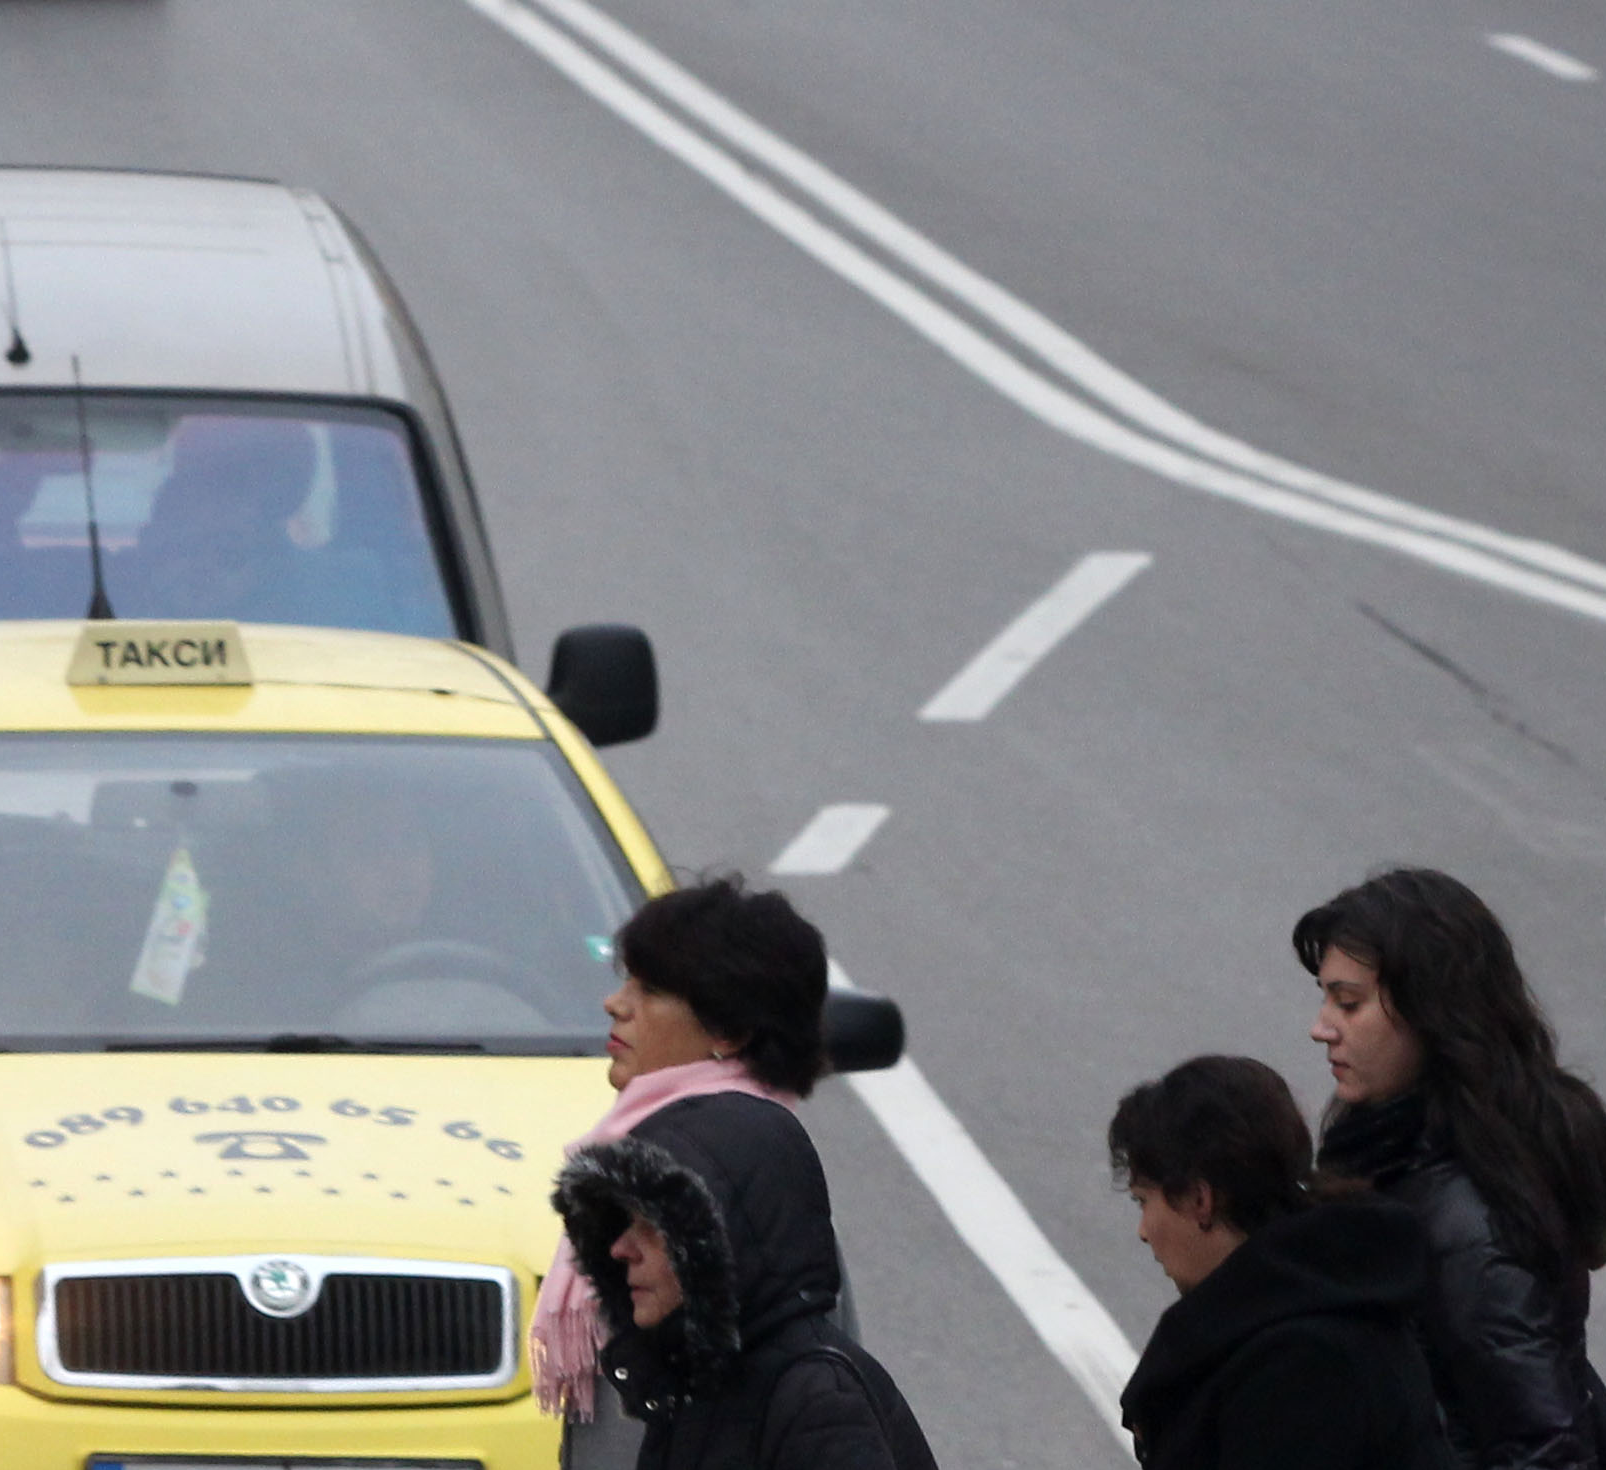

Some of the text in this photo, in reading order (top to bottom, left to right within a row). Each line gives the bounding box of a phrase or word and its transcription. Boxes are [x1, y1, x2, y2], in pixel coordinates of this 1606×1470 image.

[96, 638, 227, 668] ТАКСИ
[24, 1094, 524, 1160] 089 640 65 66
